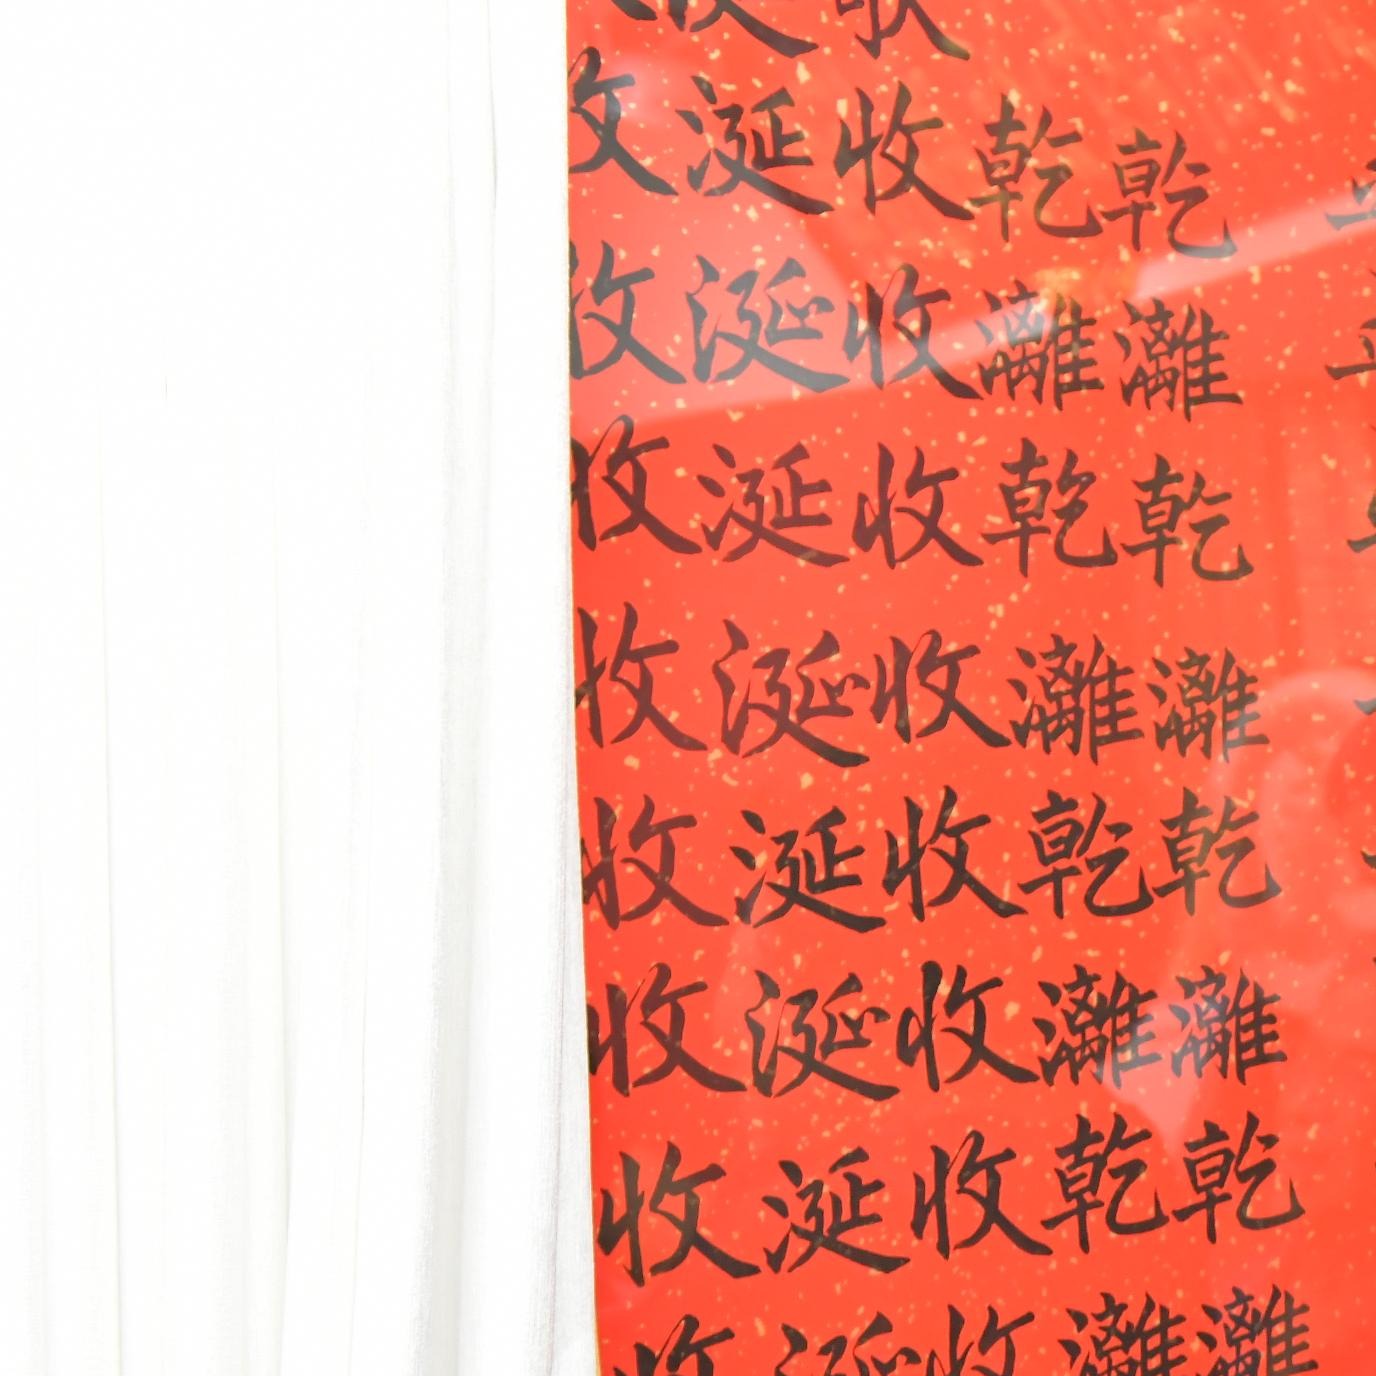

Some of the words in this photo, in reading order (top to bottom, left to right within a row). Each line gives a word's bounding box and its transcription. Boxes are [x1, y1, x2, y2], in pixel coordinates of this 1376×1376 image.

[570, 415, 1253, 588] 收涎收乾乾
[583, 785, 1282, 932] 收涎收乾乾
[598, 1111, 1305, 1289] 收涎收乾乾
